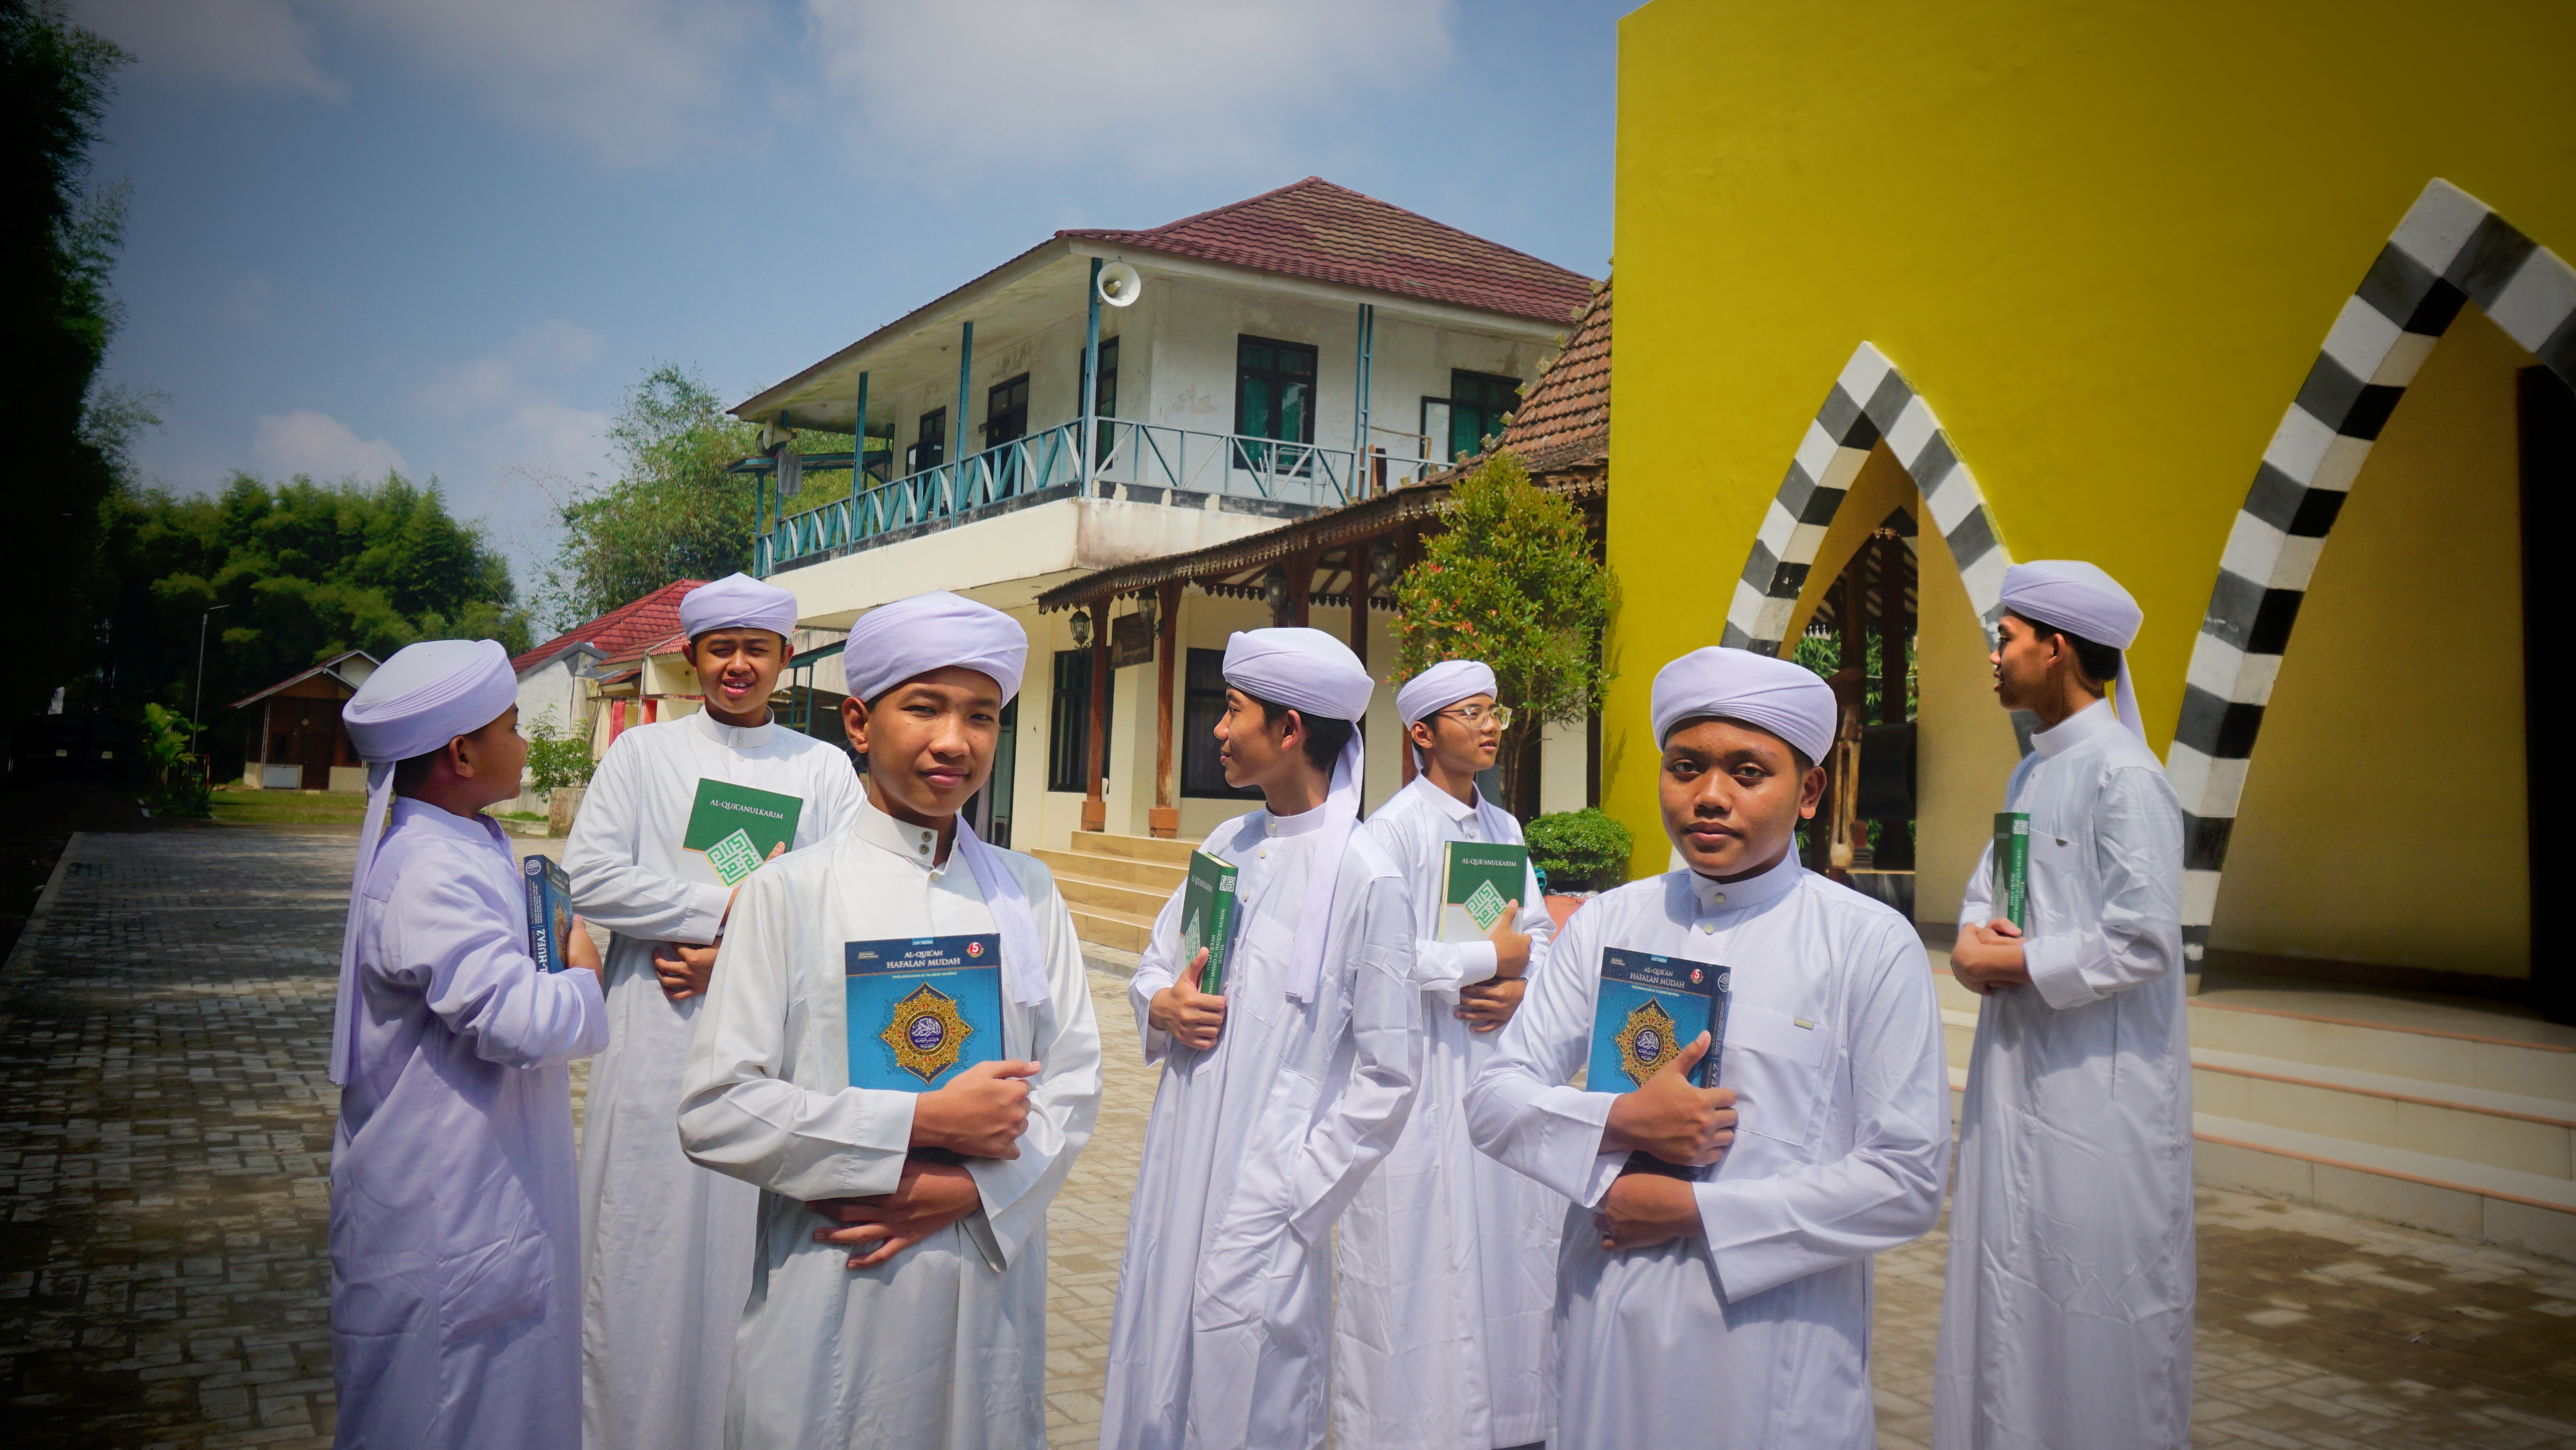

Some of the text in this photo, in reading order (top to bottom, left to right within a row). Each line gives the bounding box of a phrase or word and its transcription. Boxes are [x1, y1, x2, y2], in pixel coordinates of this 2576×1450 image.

[710, 799, 783, 819] AL-QUR'ANULKARIM
[536, 929, 548, 973] L-HUFAZ
[972, 942, 979, 953] 5
[904, 950, 943, 958] AL-QUR'AN
[886, 958, 960, 968] HAFALAN MUDAH
[1644, 967, 1673, 976] AL-QUR'AN
[1694, 969, 1700, 979] 5
[1630, 972, 1659, 984] HAFALAN
[1659, 979, 1685, 988] MUDAH
